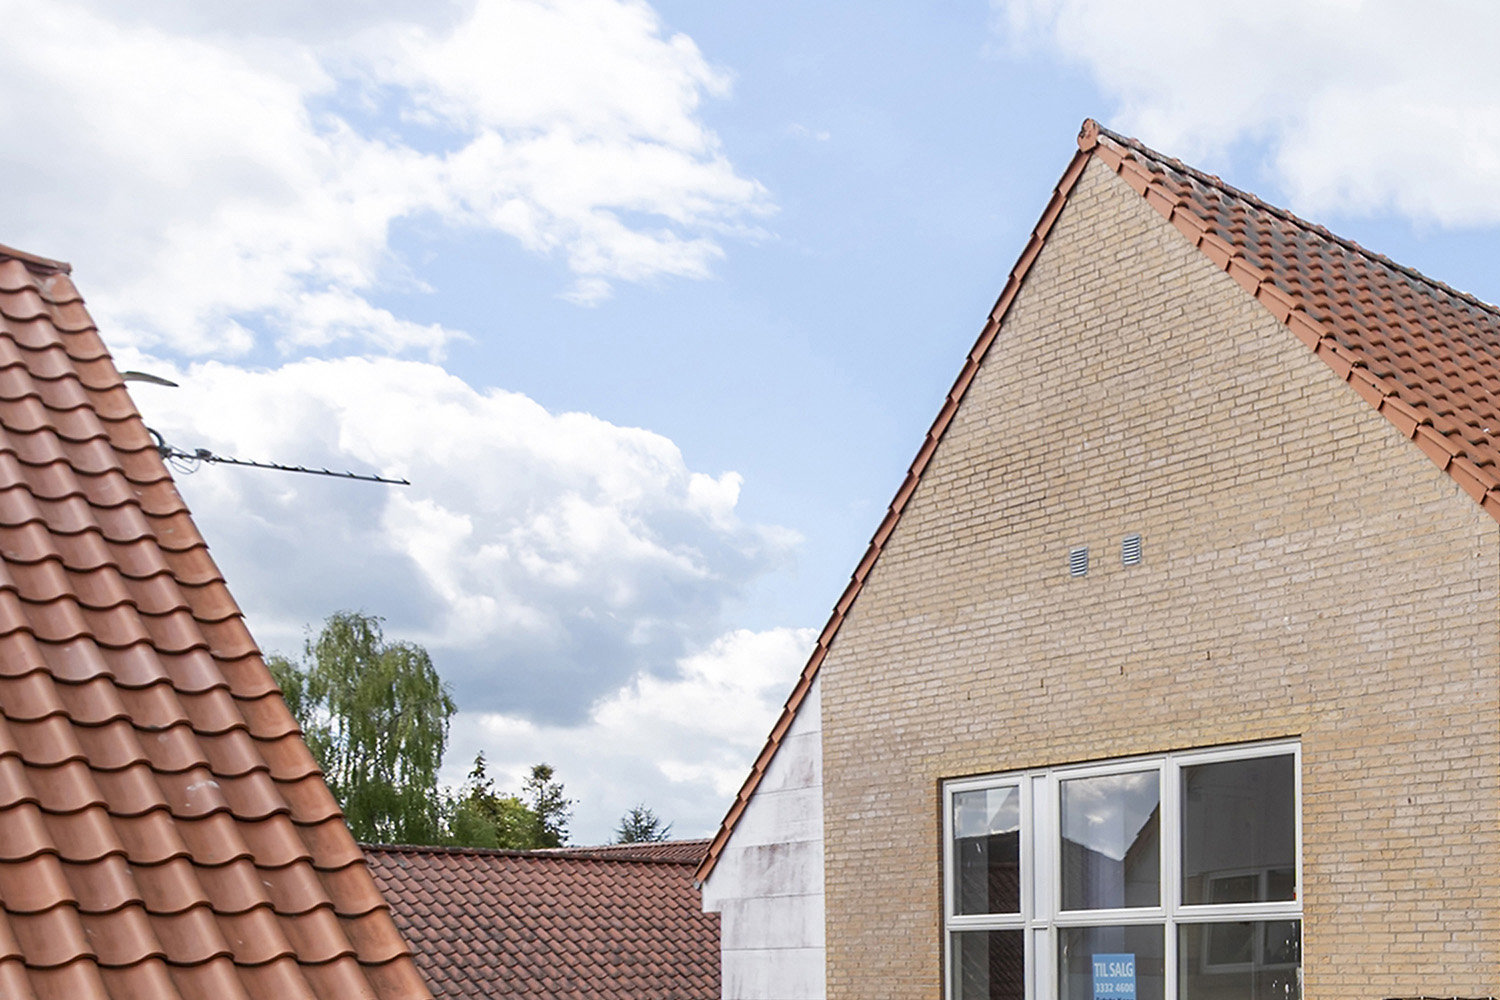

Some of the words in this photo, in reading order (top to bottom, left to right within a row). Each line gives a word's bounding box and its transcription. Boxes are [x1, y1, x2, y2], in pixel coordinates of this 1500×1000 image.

[1094, 963, 1109, 977] TIL
[1109, 963, 1133, 977] SALG
[1096, 983, 1114, 992] 3332
